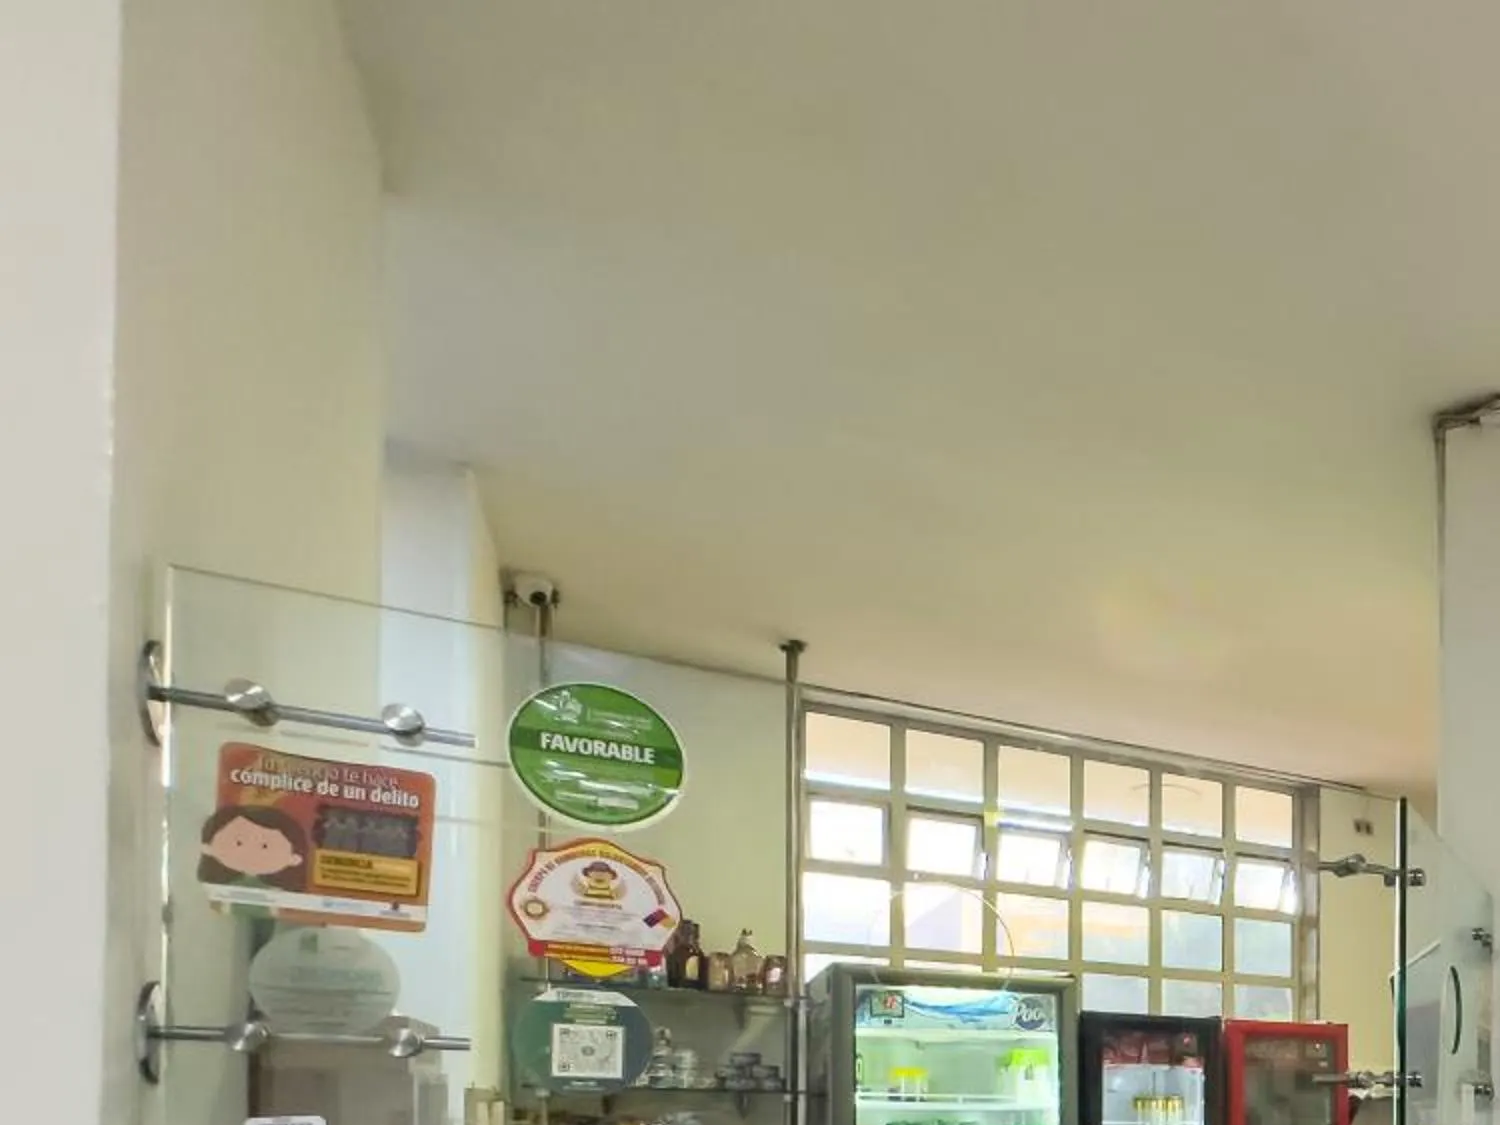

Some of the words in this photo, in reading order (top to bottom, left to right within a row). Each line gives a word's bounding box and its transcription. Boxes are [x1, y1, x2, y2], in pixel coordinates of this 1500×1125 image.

[540, 732, 655, 764] FAVORABLE
[230, 766, 314, 793] cómplice
[317, 777, 340, 797] de
[343, 785, 367, 801] un
[370, 784, 420, 809] delito
